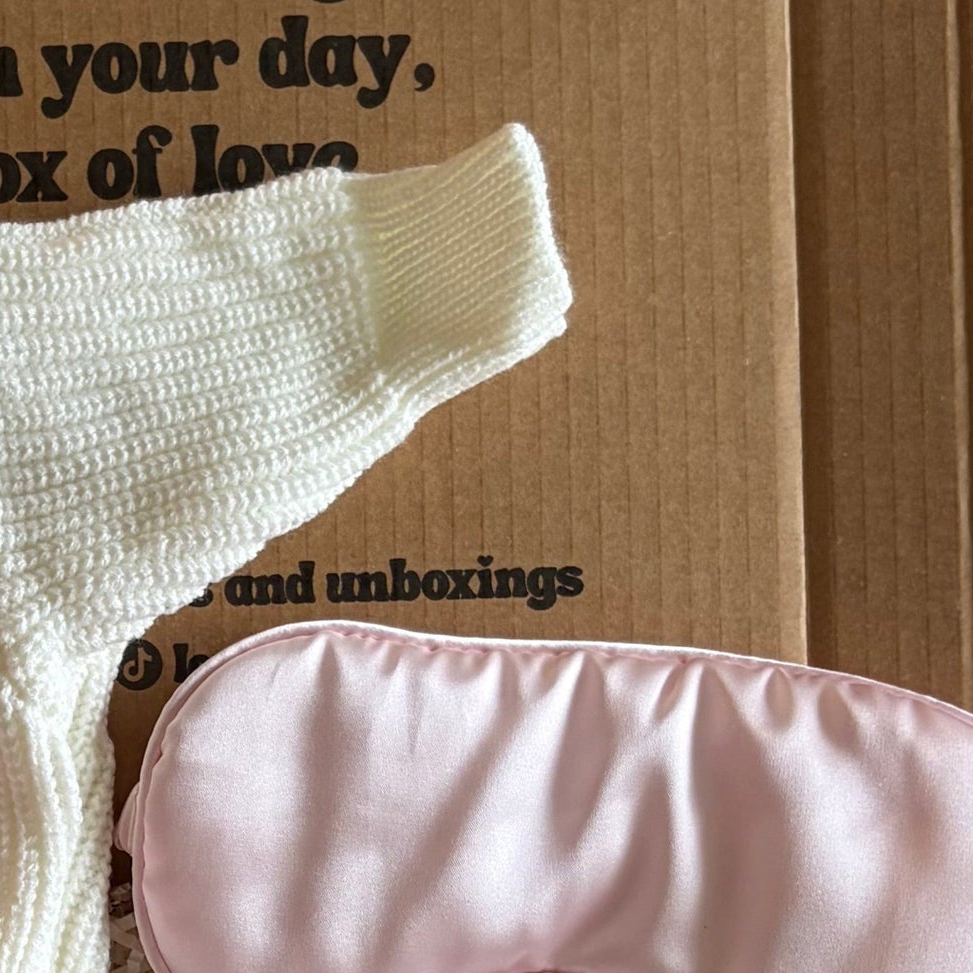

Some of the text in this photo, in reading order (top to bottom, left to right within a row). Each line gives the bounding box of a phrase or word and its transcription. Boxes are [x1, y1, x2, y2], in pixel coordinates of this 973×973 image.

[41, 38, 239, 119] your
[258, 14, 436, 109] day,
[87, 124, 173, 200] of
[224, 561, 317, 607] and
[326, 555, 585, 611] unboxings
